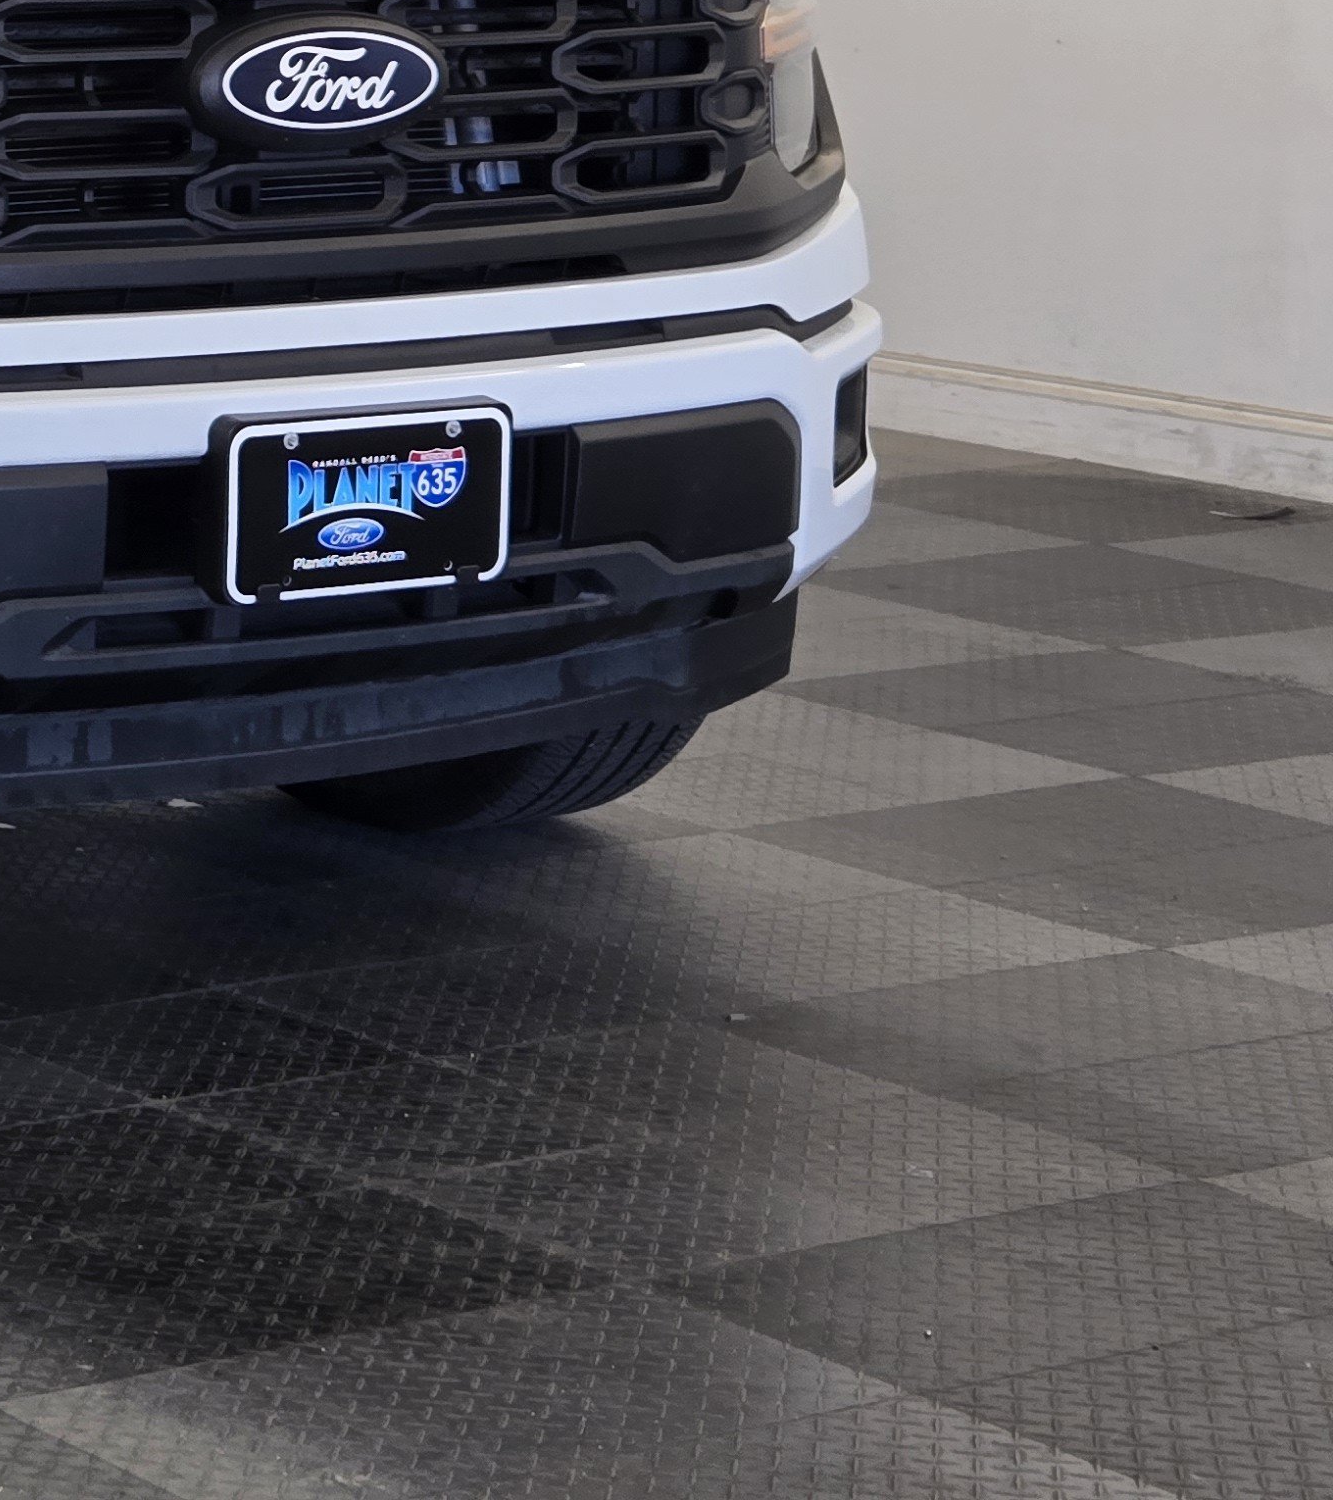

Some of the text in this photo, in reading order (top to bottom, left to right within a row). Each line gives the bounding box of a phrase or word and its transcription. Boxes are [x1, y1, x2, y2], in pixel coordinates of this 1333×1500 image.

[265, 45, 399, 113] Ford
[288, 460, 416, 527] PLANET
[417, 467, 458, 497] 635
[330, 523, 371, 545] Ford
